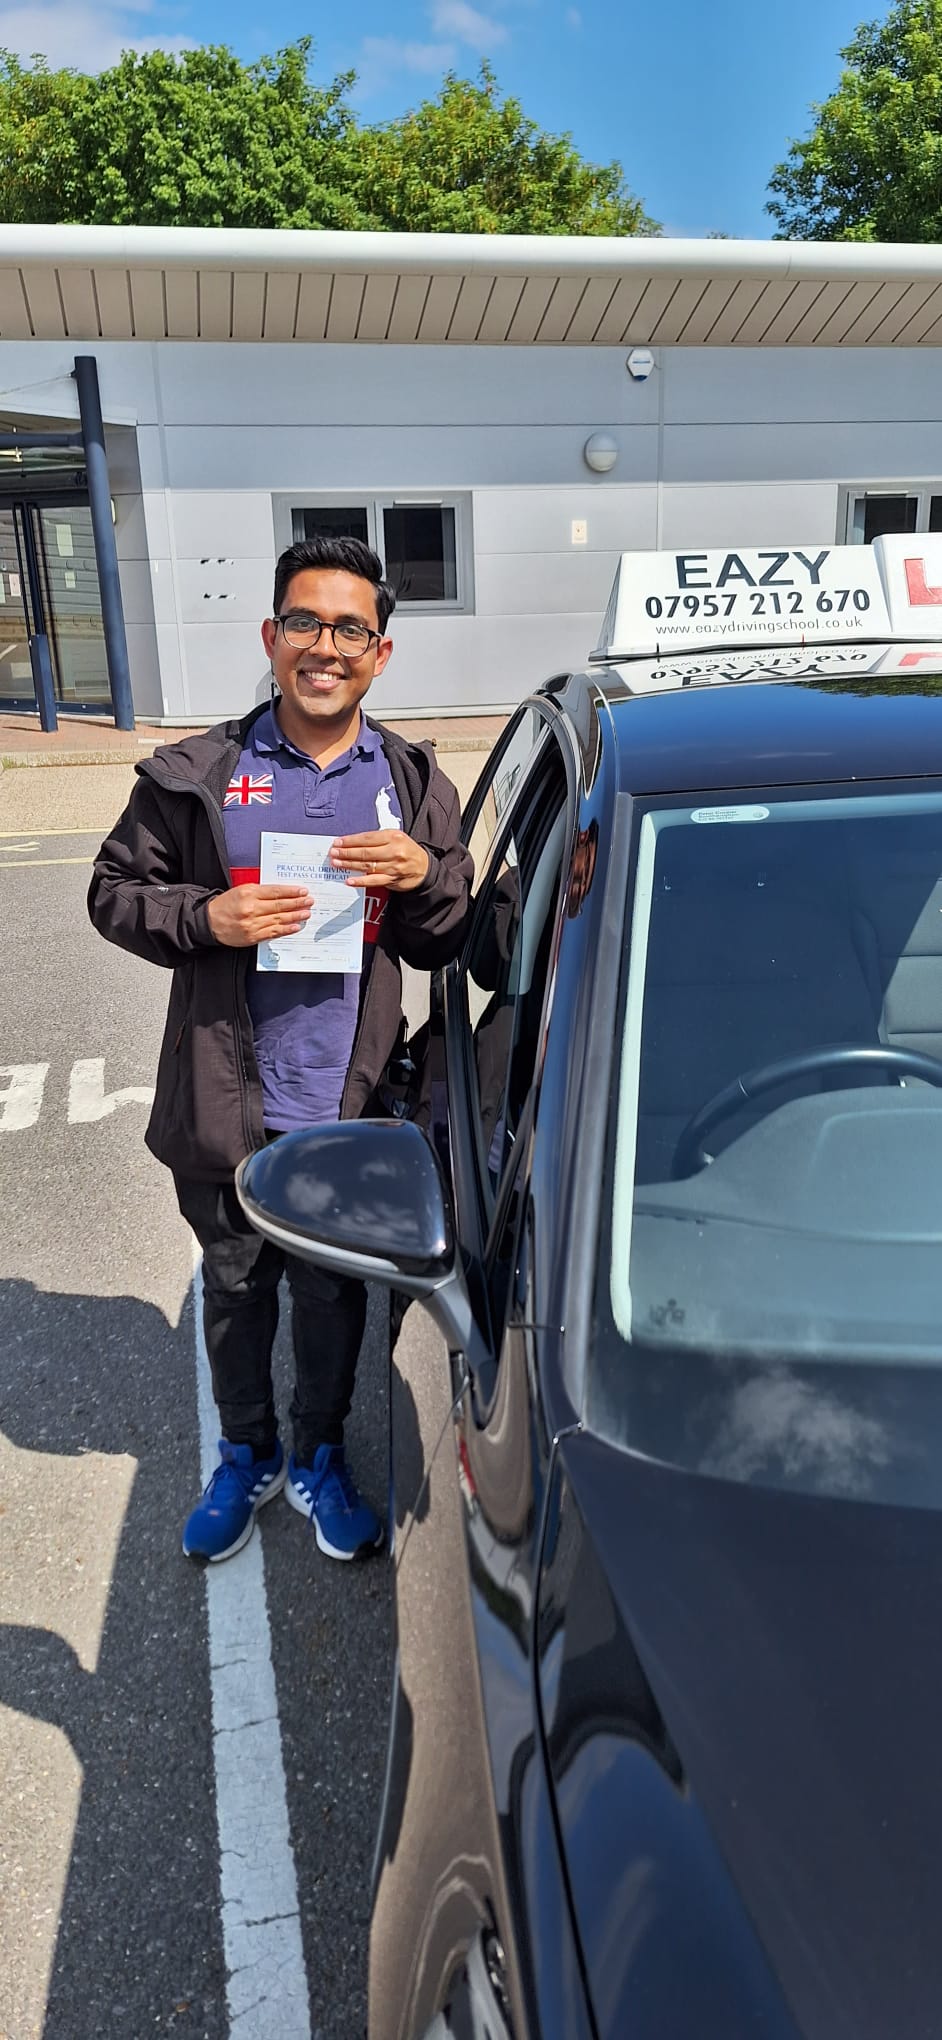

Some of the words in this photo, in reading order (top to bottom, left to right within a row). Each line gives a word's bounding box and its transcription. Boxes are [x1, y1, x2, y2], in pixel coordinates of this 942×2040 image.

[675, 550, 831, 589] EAZY
[904, 558, 942, 607] L
[645, 593, 737, 618] 07957
[749, 591, 804, 615] 212
[816, 588, 870, 613] 670
[276, 864, 315, 872] PRACTICAL
